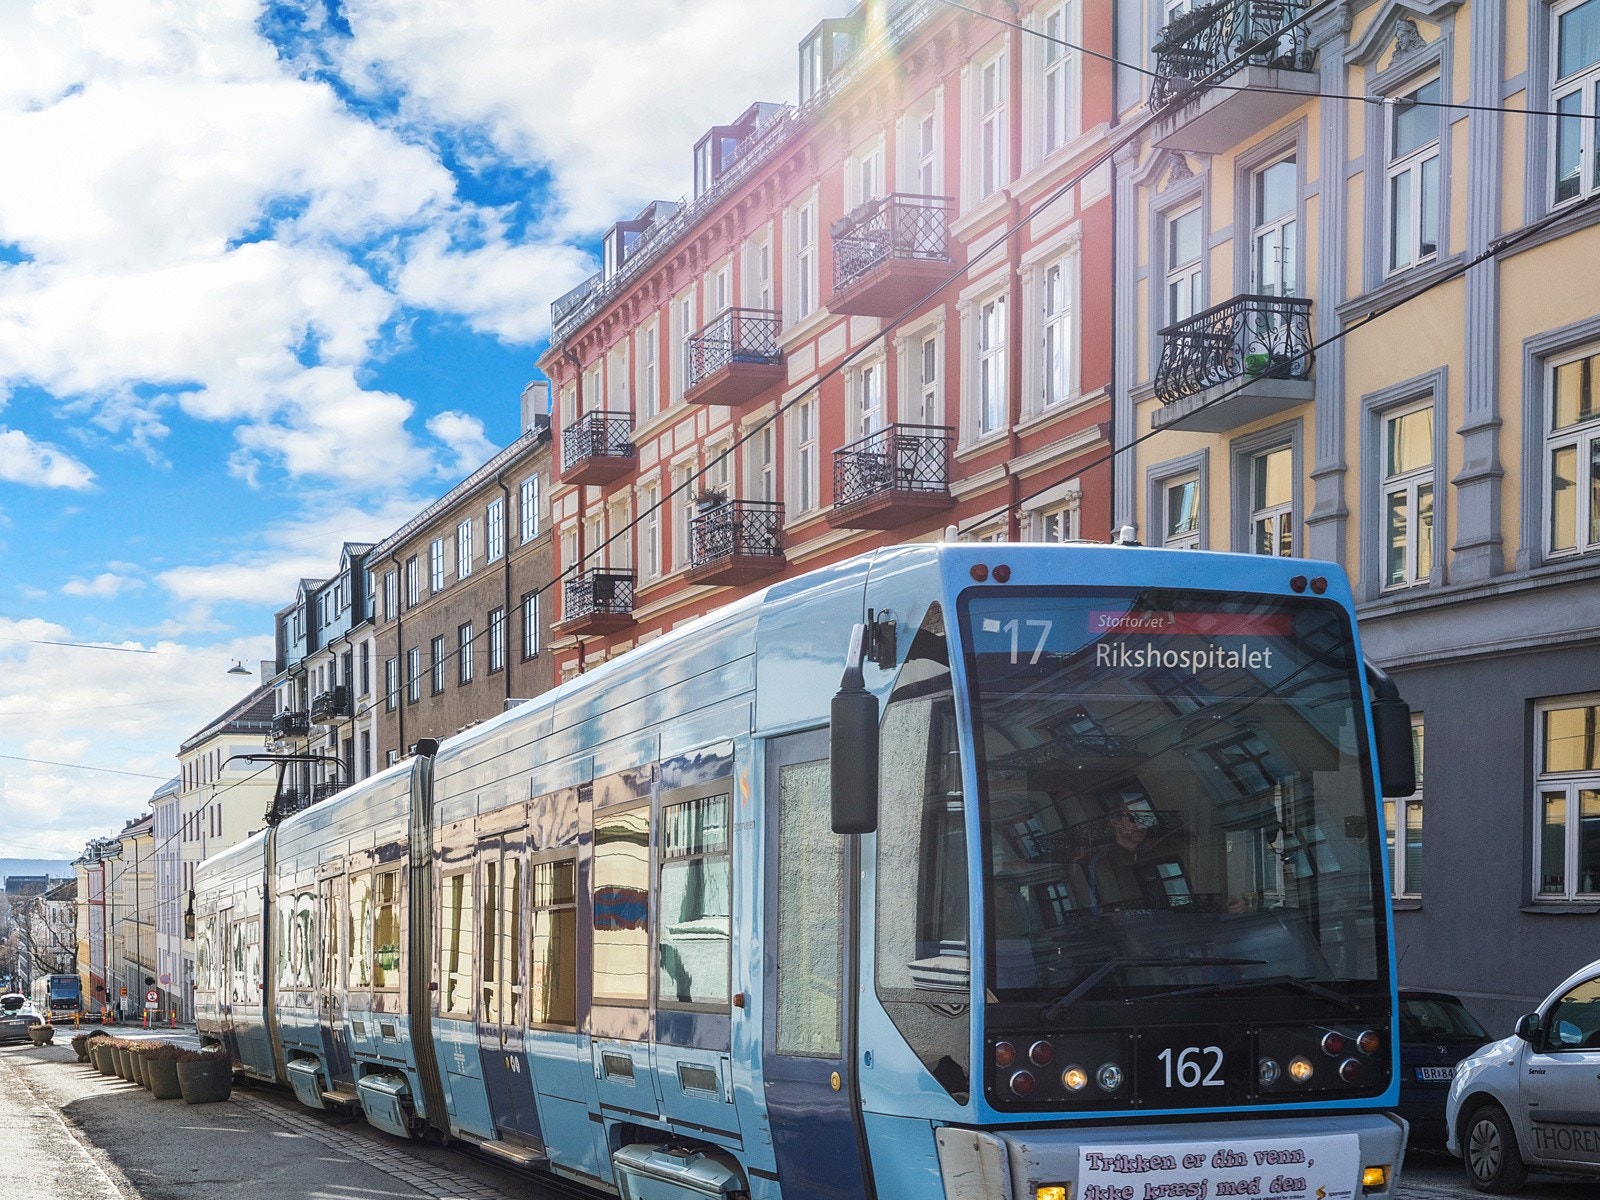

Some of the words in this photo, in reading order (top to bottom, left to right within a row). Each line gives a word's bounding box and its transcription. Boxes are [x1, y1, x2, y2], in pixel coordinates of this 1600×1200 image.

[1098, 614, 1164, 628] Stortorvet
[1003, 619, 1053, 665] 17
[1096, 642, 1273, 674] Rikshospitalet
[1157, 1046, 1226, 1089] 162
[1424, 1068, 1438, 1079] BR
[1528, 1067, 1546, 1075] Service
[1086, 1152, 1177, 1173] Trikken
[1183, 1153, 1206, 1169] er
[1211, 1149, 1248, 1169] din
[1216, 1176, 1261, 1197] med
[1269, 1175, 1307, 1194] den
